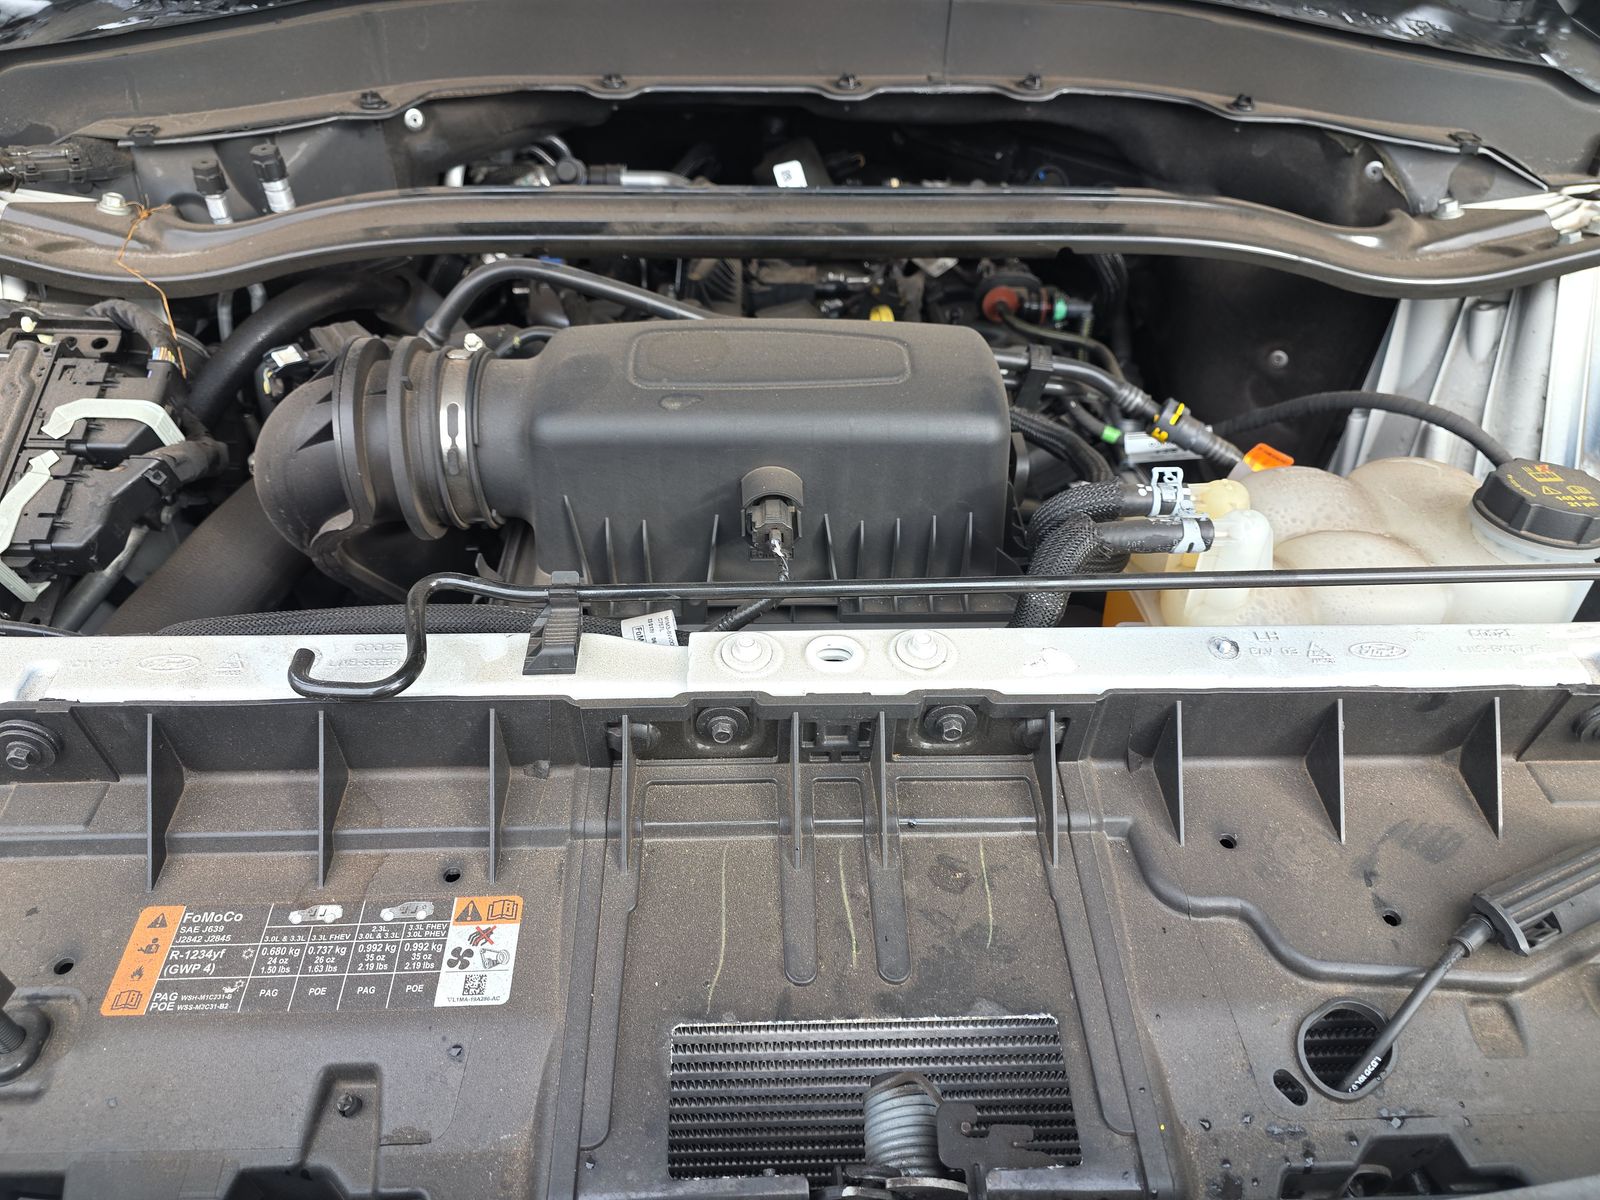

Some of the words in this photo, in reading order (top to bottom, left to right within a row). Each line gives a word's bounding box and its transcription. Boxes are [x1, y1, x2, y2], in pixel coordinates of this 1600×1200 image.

[182, 911, 244, 923] FoMoCo
[261, 947, 287, 955] 0.680
[289, 947, 300, 956] kg
[308, 946, 334, 954] 0.737
[335, 946, 347, 955] kg
[358, 944, 383, 952] 0.992
[385, 943, 397, 953] kg
[404, 942, 429, 951] 0.992
[431, 942, 443, 952] kg
[169, 950, 225, 960] R-1234yf
[164, 964, 201, 976] (GWP
[203, 964, 215, 975] 4)
[259, 989, 278, 997] PAG
[308, 987, 327, 996] POE
[356, 986, 376, 994] PAG
[405, 984, 424, 993] POE
[153, 992, 178, 1002] PAG
[149, 1002, 175, 1011] POE
